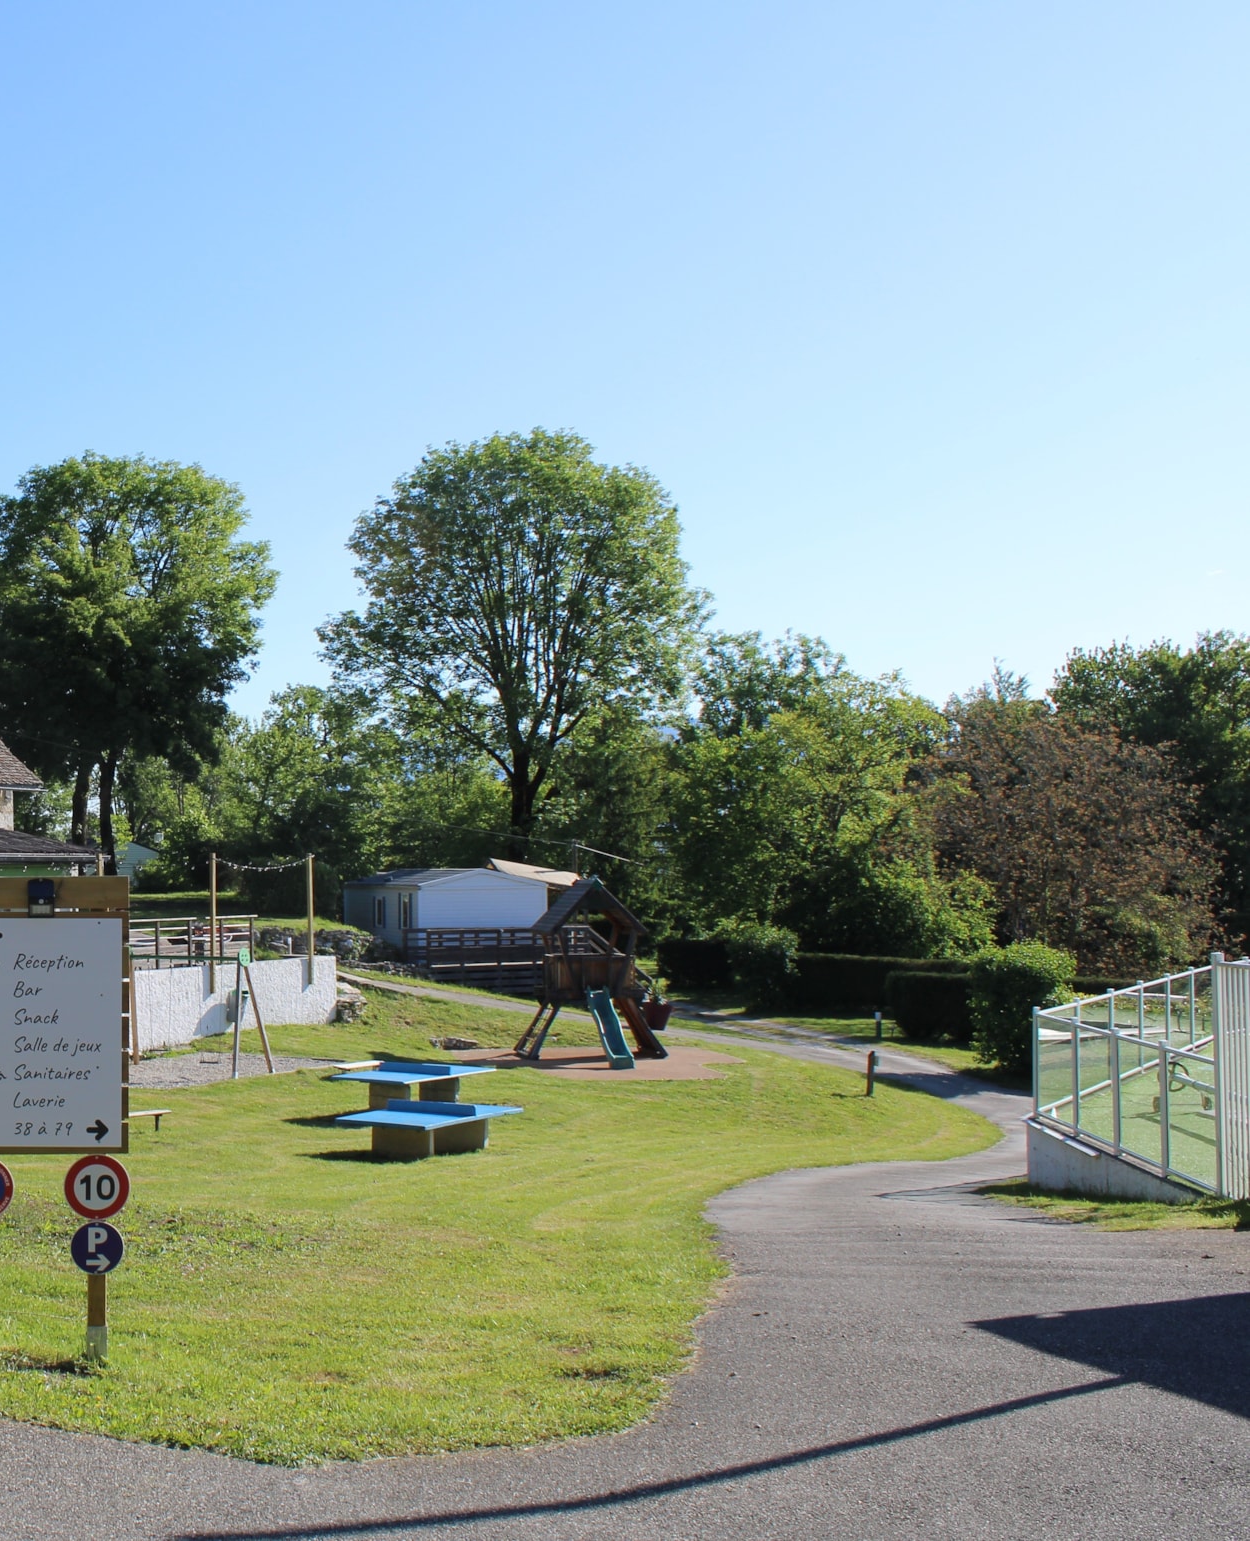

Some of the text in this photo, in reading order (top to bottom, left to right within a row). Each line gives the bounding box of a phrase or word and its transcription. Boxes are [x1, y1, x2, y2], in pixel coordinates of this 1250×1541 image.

[13, 953, 84, 973] Réception
[13, 981, 43, 998] Bar
[13, 1008, 60, 1025] Snack
[13, 1035, 102, 1057] Salle de jeux
[13, 1063, 91, 1081] Sanitaires
[13, 1091, 66, 1108] Laverie
[13, 1121, 74, 1136] 38 à 79
[80, 1174, 115, 1201] 10
[87, 1226, 108, 1254] P
